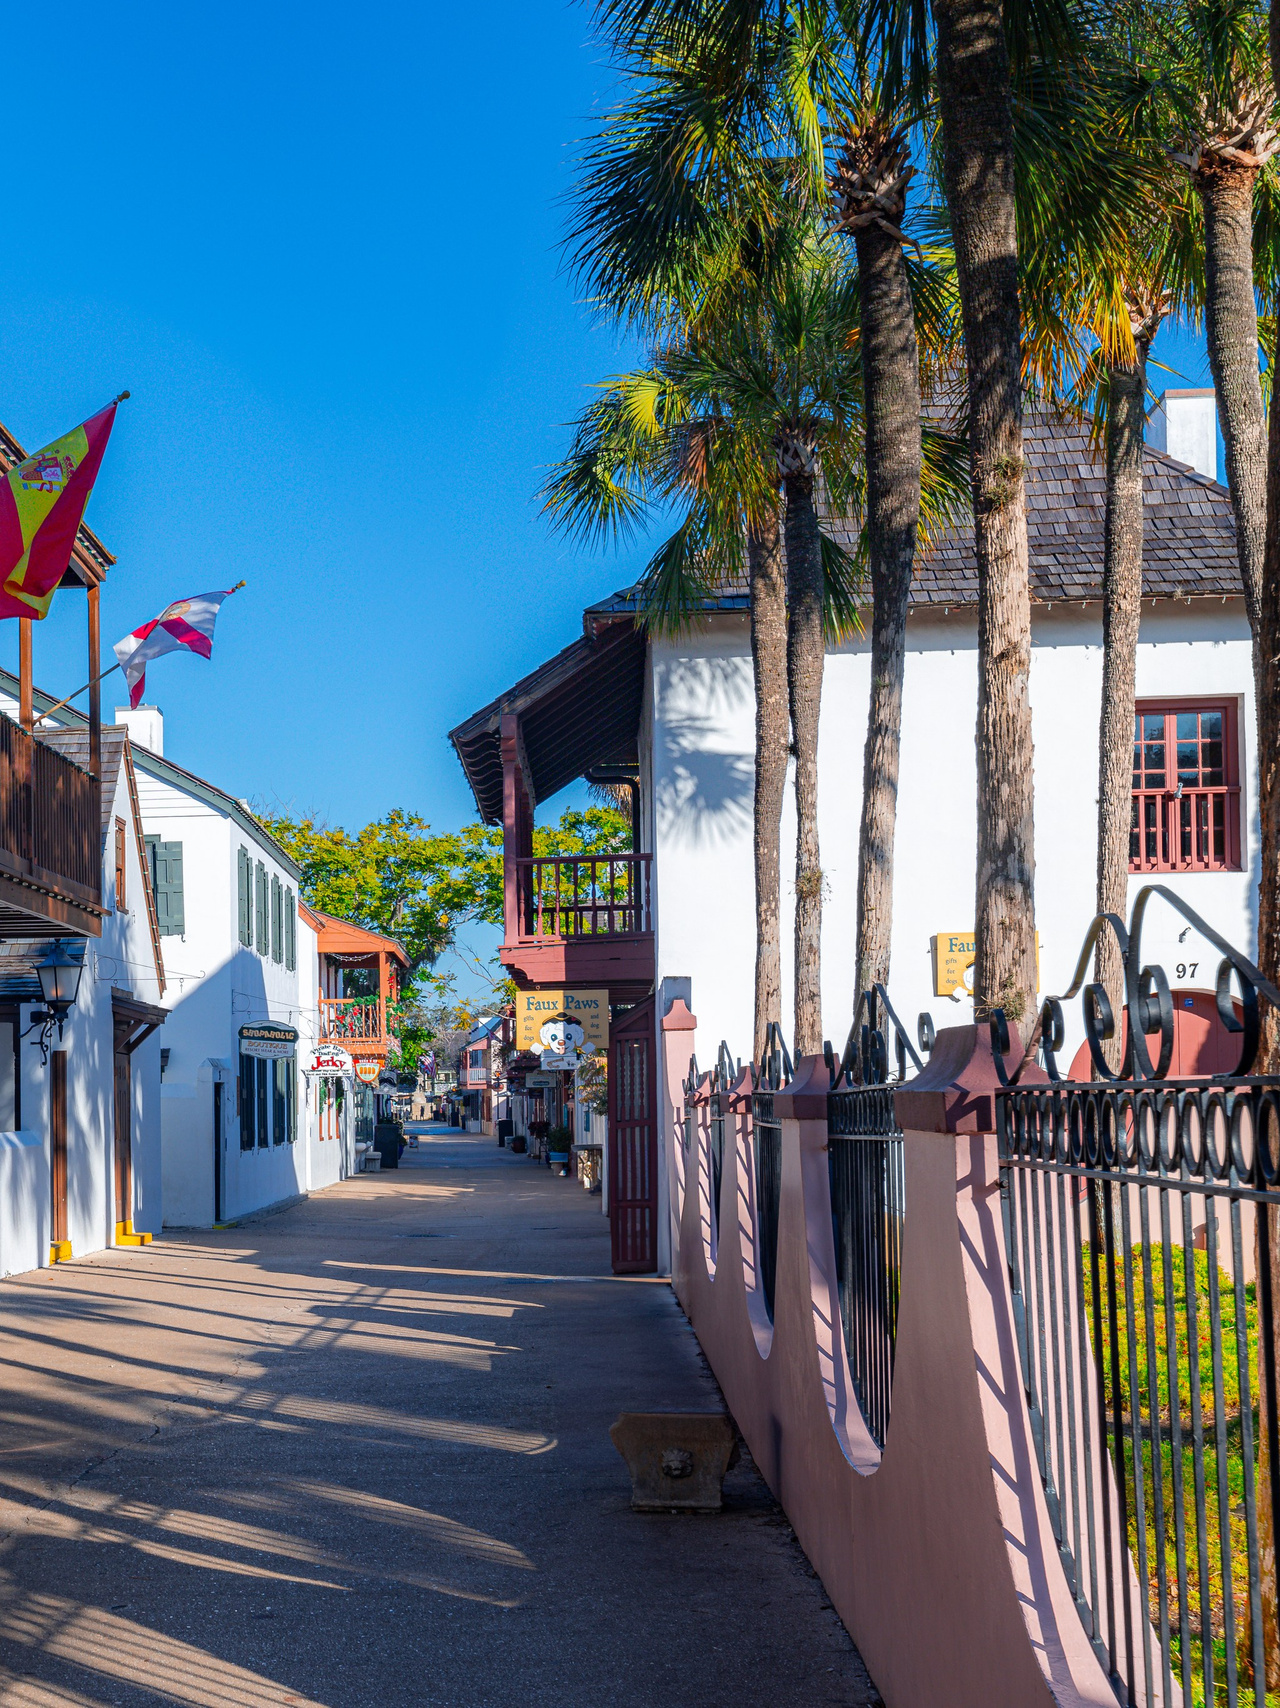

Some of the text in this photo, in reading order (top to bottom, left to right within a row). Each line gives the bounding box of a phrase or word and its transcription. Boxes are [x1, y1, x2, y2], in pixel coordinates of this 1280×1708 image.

[948, 937, 976, 953] Fau
[1176, 962, 1199, 980] 97
[526, 995, 599, 1011] Faux Paws
[523, 1014, 534, 1022] gifts
[242, 1029, 295, 1040] SHOPAHOLIC
[247, 1040, 288, 1050] BOUTIQUE
[311, 1056, 346, 1070] Jerky
